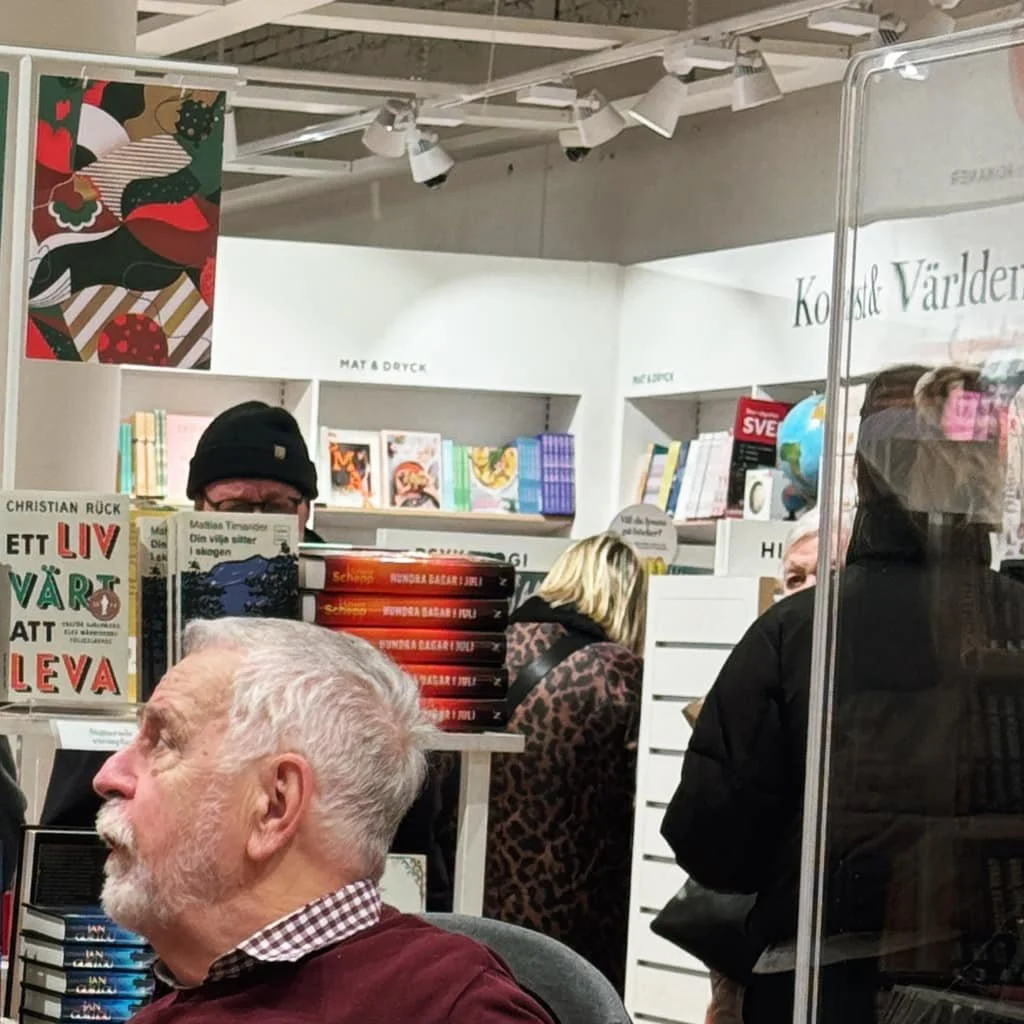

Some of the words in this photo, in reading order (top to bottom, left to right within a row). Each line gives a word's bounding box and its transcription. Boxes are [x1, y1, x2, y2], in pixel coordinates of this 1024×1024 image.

[340, 359, 366, 371] MAT
[383, 361, 427, 373] DRYCK
[743, 416, 777, 438] SVE
[6, 500, 78, 514] CHRISTIAN
[86, 500, 121, 515] RÜCK
[6, 534, 49, 555] ETT
[57, 521, 121, 560] LIV
[189, 534, 207, 544] Din
[760, 541, 782, 559] HI
[8, 564, 121, 611] VÄRT
[10, 621, 56, 642] ATT
[10, 652, 121, 695] LEVA
